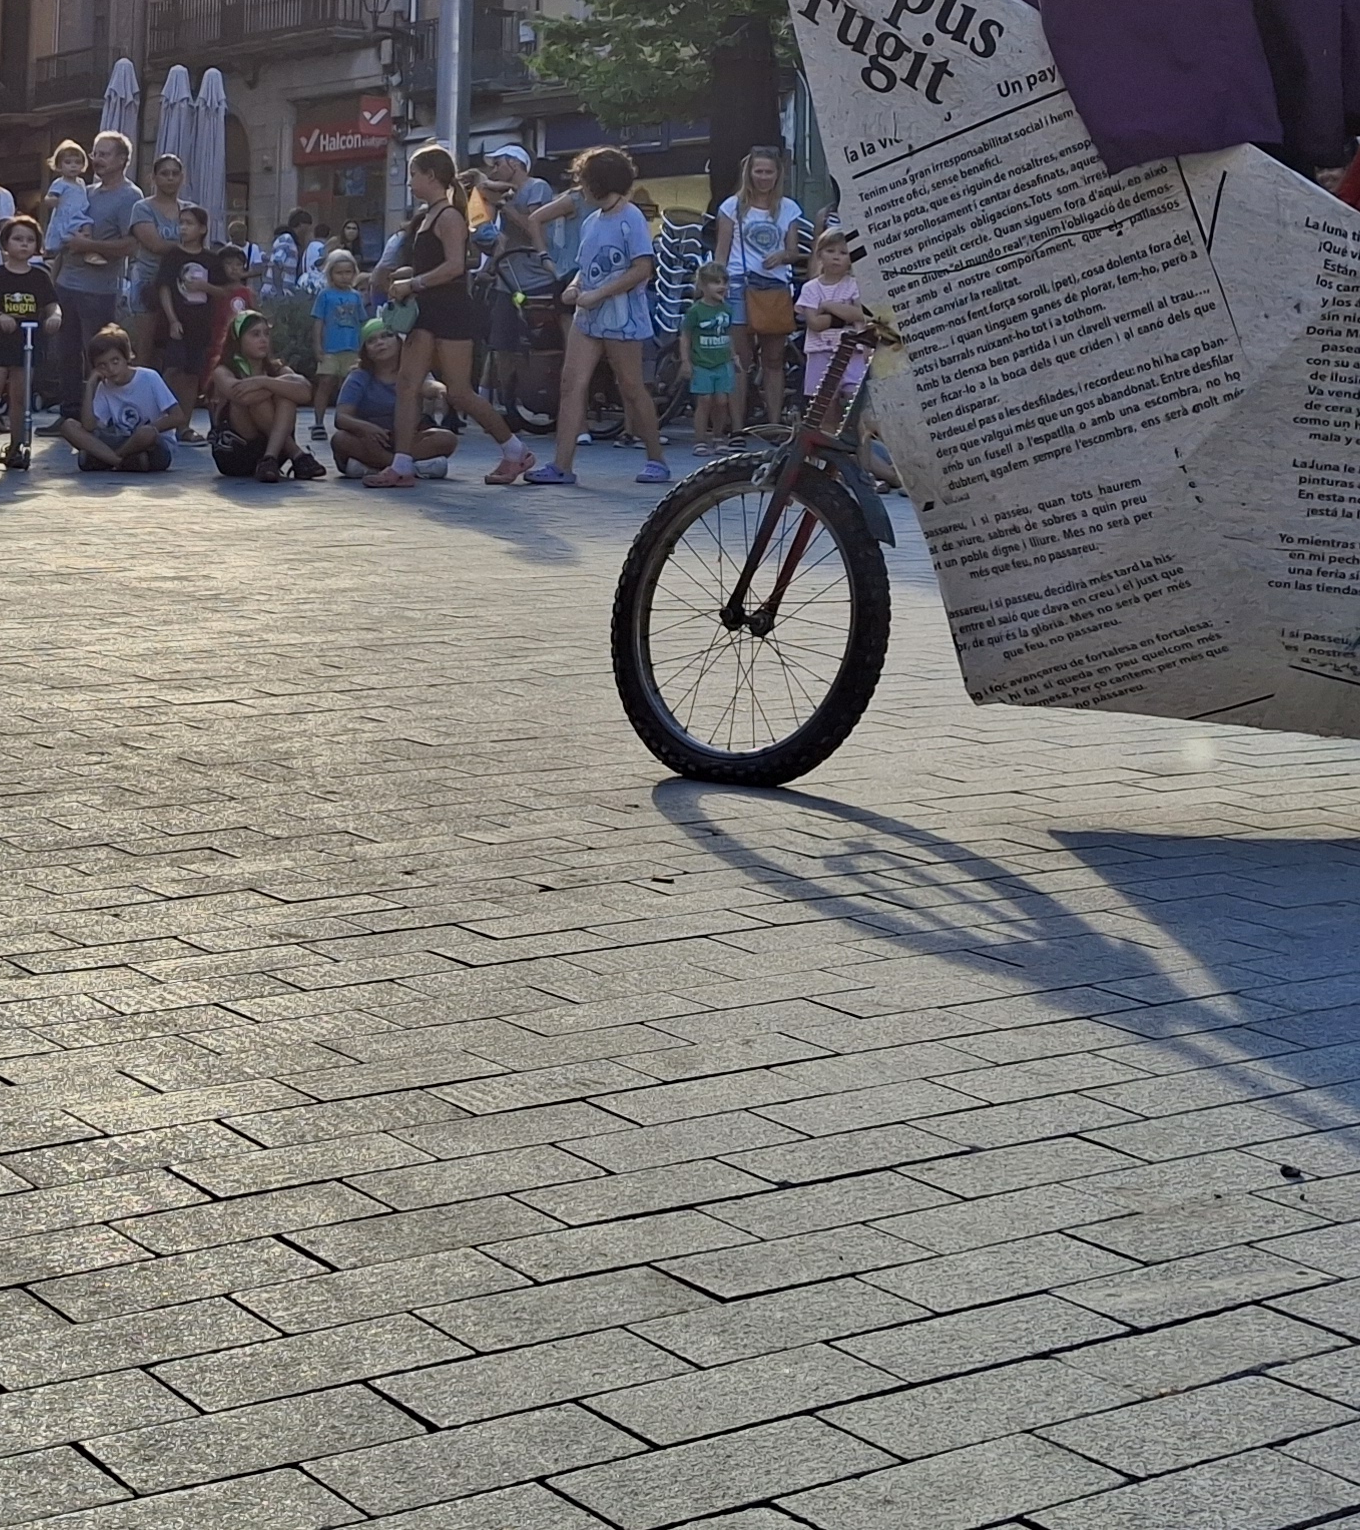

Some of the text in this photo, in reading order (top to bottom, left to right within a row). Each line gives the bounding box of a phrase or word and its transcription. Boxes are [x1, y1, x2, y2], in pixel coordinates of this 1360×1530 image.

[996, 79, 1022, 97] Un
[319, 130, 361, 152] Halcón
[857, 185, 888, 202] Tenim
[908, 169, 931, 185] gran
[930, 132, 1013, 172] irresponsabilitat
[1013, 119, 1043, 138] social
[1049, 109, 1073, 124] hem
[864, 205, 872, 218] al
[874, 195, 905, 213] nostre
[905, 185, 930, 201] ofici,
[930, 173, 958, 191] sense
[1304, 216, 1319, 230] La
[1321, 220, 1347, 239] luna
[1315, 275, 1332, 289] los
[1305, 325, 1342, 336] Doña
[1307, 384, 1323, 395] Va
[1292, 416, 1329, 426] como
[1333, 420, 1350, 431] un
[1297, 488, 1313, 499] En
[1317, 493, 1344, 502] esta
[1278, 532, 1294, 543] Yo
[1297, 535, 1355, 549] mientras
